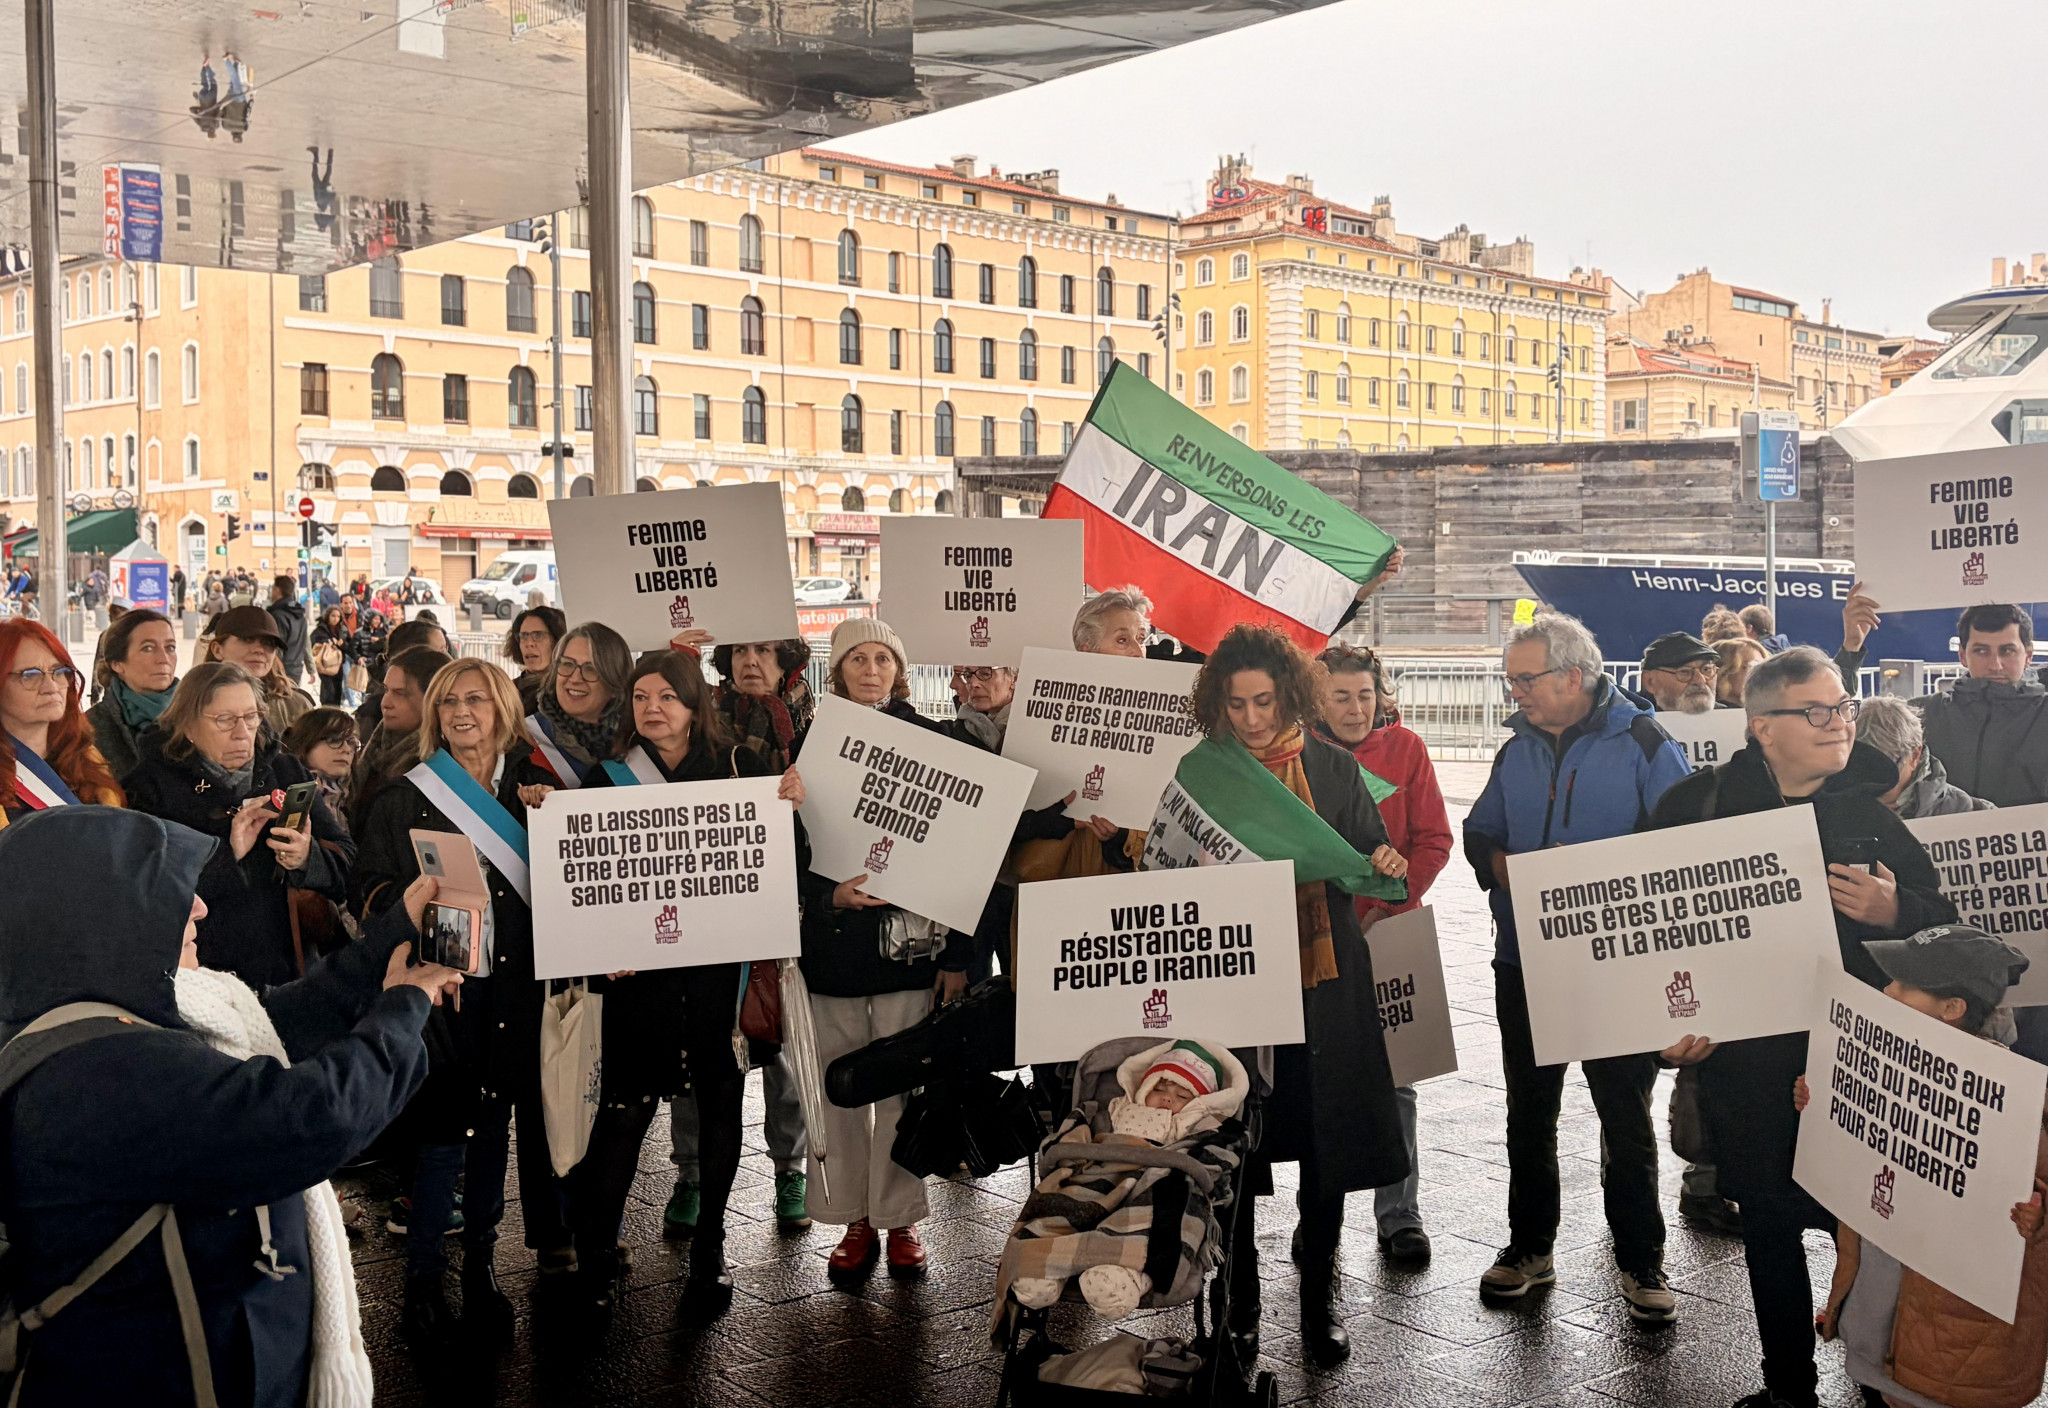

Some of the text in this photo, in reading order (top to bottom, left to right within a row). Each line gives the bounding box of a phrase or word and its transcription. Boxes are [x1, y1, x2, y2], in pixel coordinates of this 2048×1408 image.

[1166, 433, 1326, 539] RENVERSONS LES
[838, 538, 866, 547] JAIPUR
[1980, 856, 2048, 883] PEUPL
